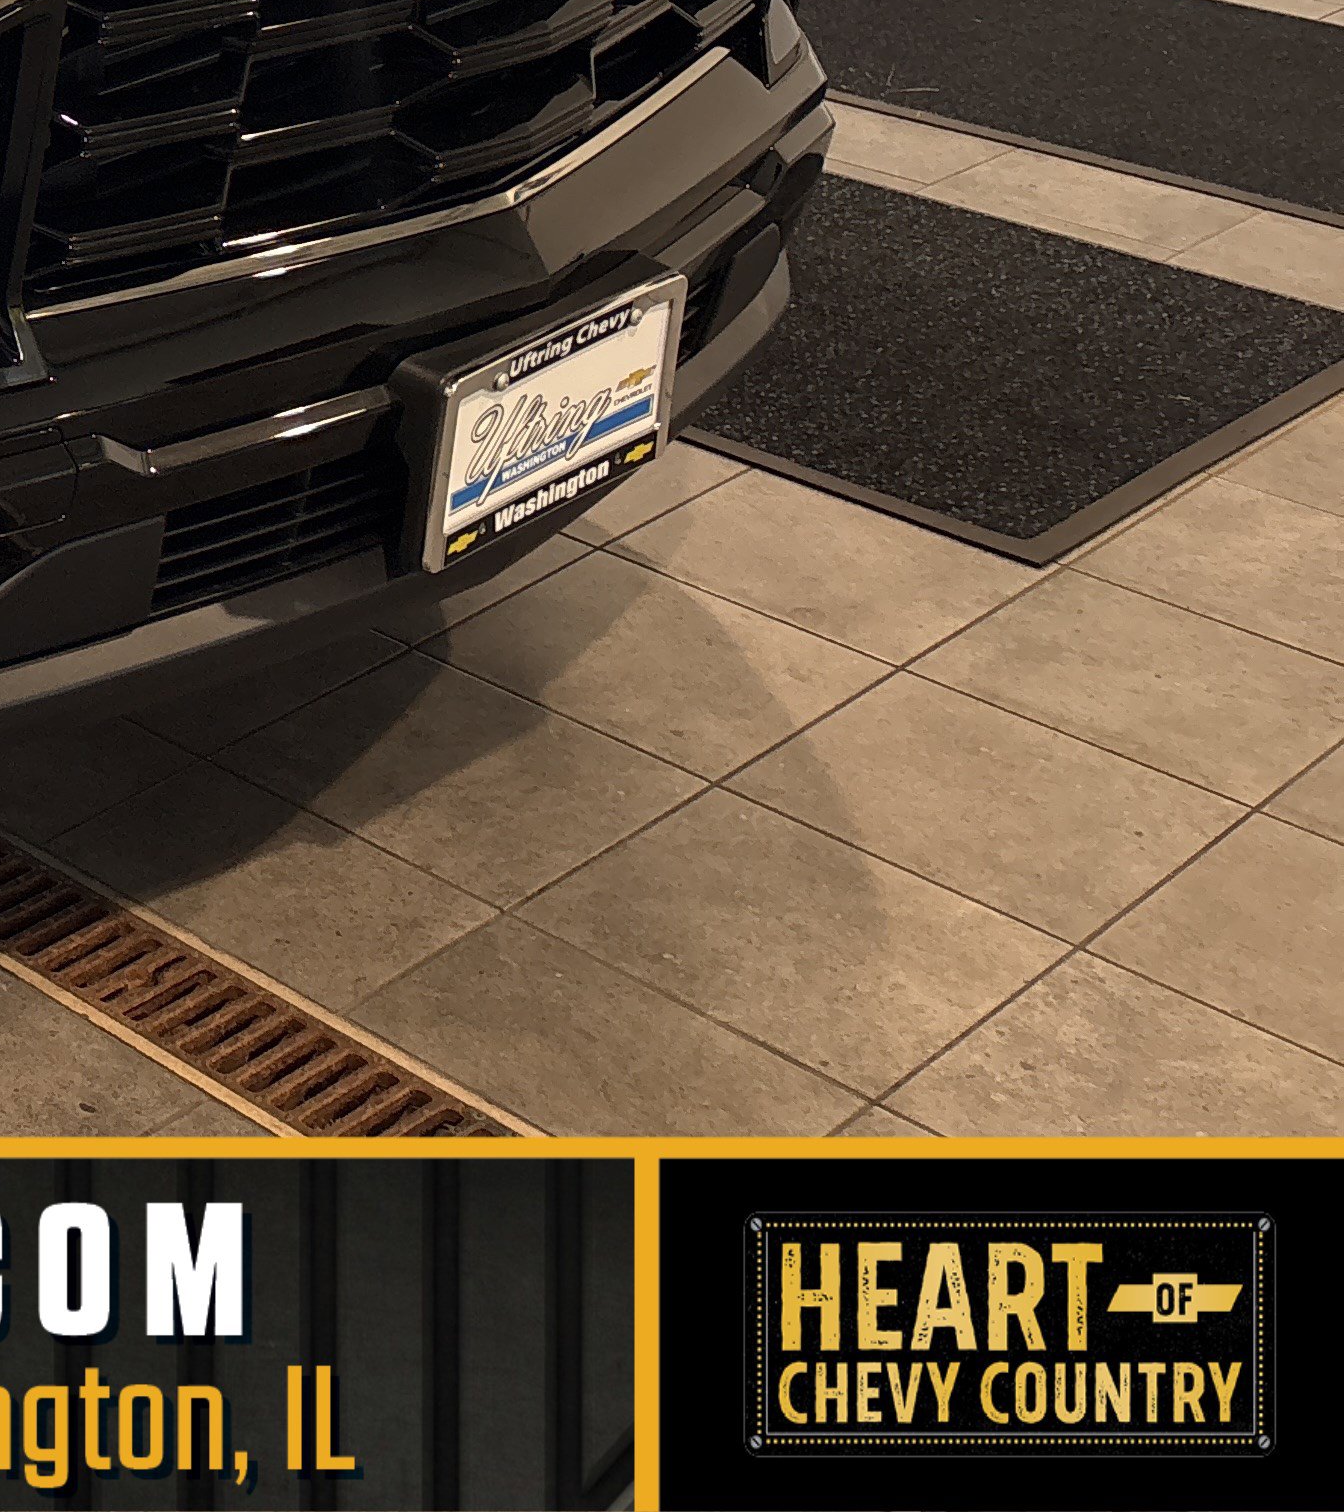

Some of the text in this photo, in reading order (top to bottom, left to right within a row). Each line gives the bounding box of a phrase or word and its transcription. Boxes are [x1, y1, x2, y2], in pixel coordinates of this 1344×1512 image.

[509, 307, 632, 380] Uftring Chevy
[613, 382, 653, 407] CHEVROLET
[465, 386, 613, 508] Uftring
[501, 441, 567, 483] WASHINGTON
[494, 459, 611, 534] Washington
